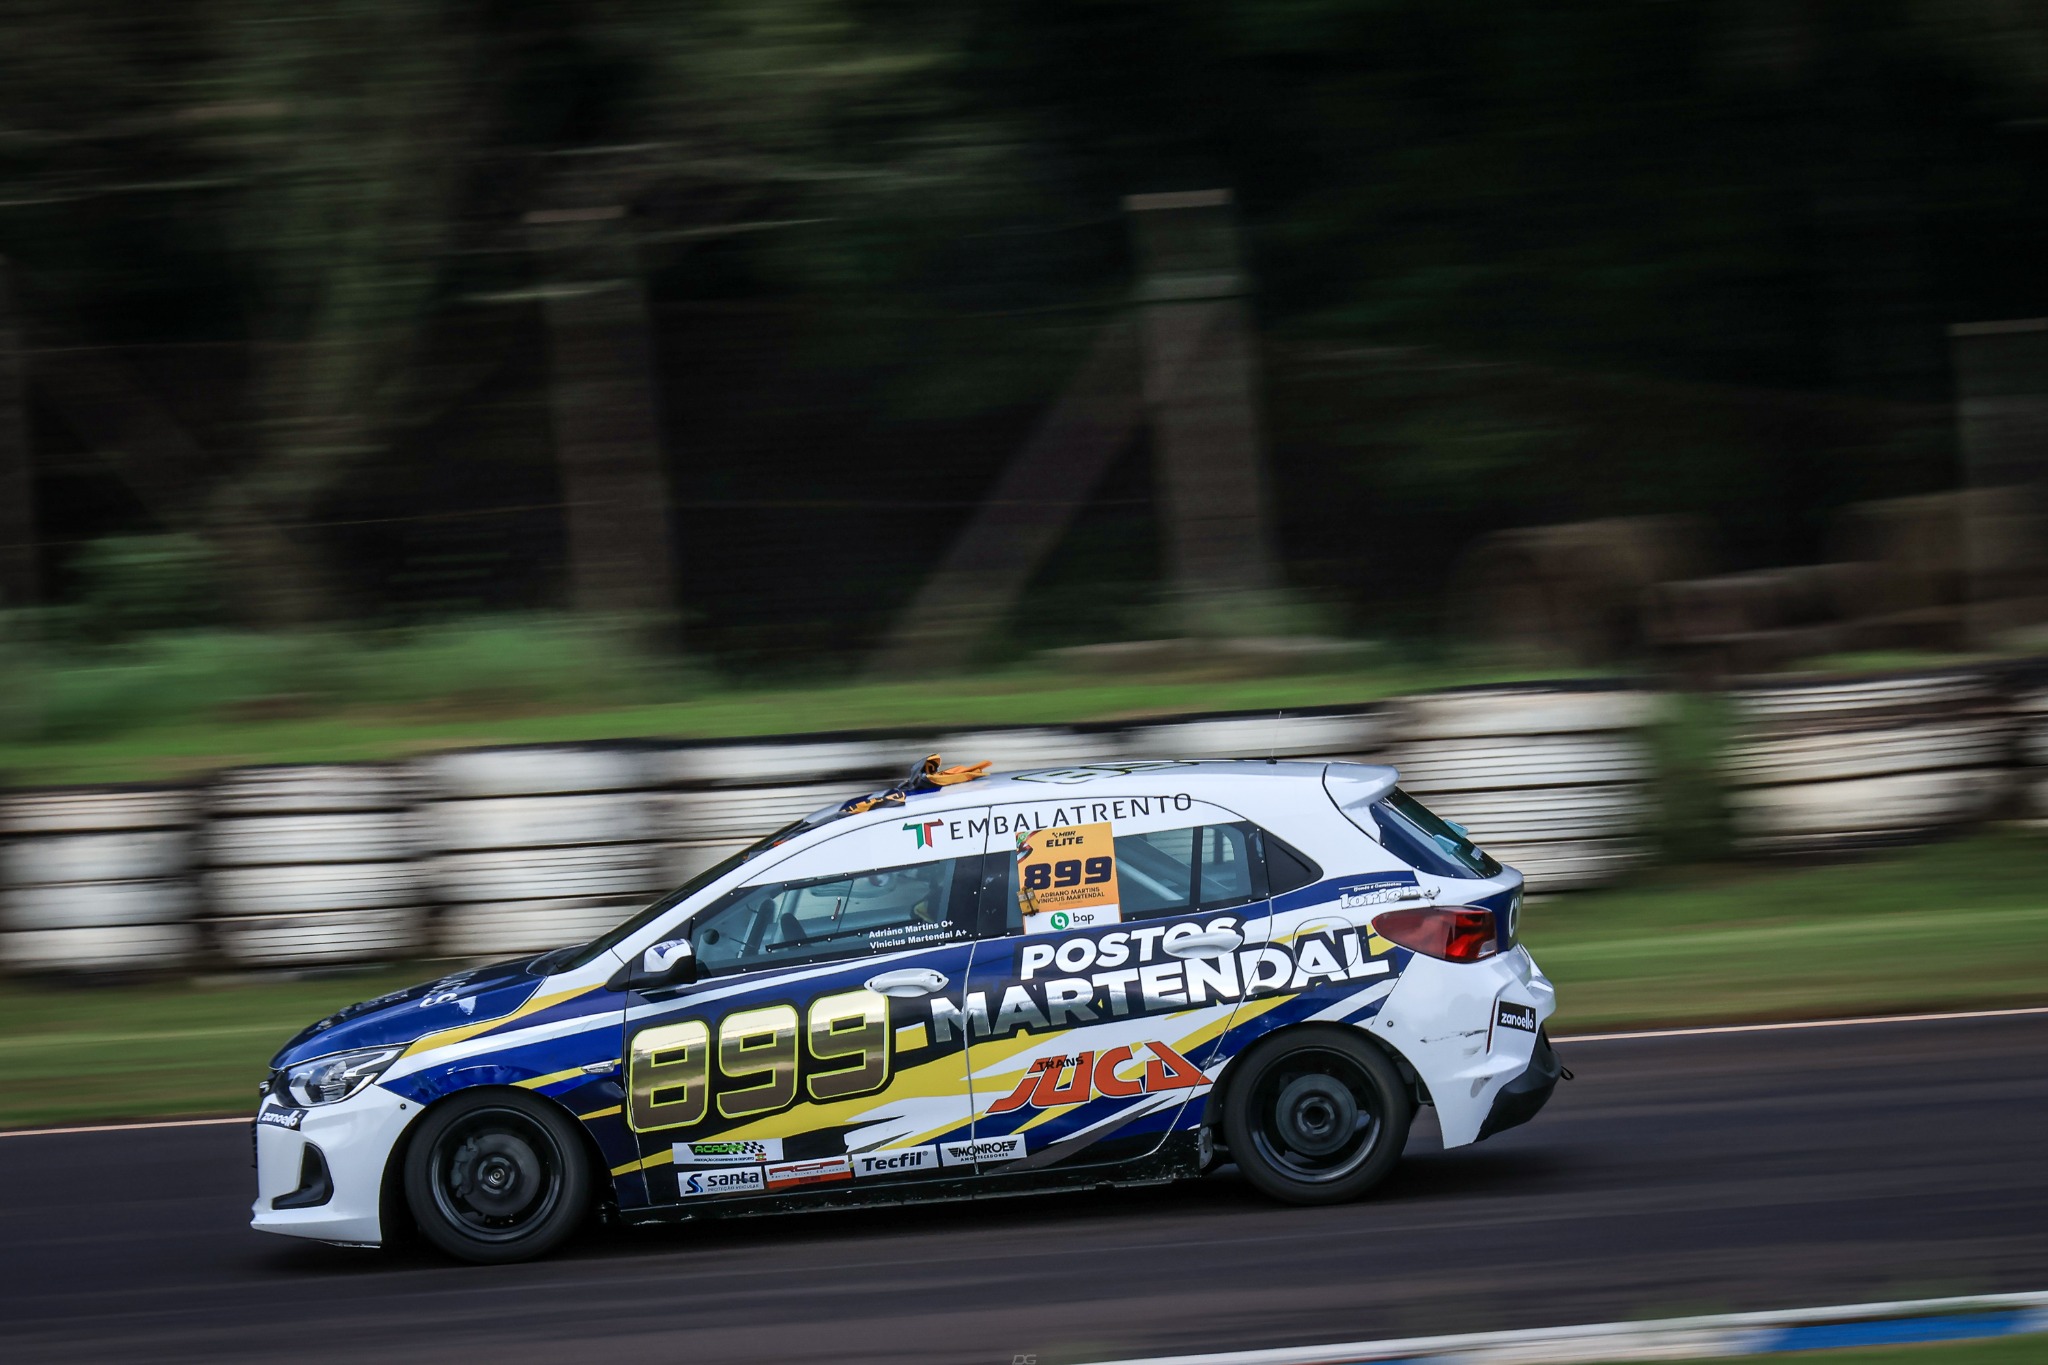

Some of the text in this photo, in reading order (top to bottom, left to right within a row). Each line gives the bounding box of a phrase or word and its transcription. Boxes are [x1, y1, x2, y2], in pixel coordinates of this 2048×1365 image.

[950, 793, 1192, 840] EMBALATRENTO
[1046, 836, 1083, 848] ELITE
[1024, 856, 1113, 890] 899
[1040, 887, 1100, 898] ADRIANO MARTINS
[1066, 892, 1105, 901] MARTENDAL
[1072, 912, 1094, 924] bap
[869, 929, 903, 939] Adriano
[905, 923, 939, 934] Martins
[870, 939, 906, 949] Vinicius
[908, 931, 953, 944] Martendal
[931, 926, 1391, 1043] MARTENDAL
[1501, 1008, 1535, 1030] zanoello
[626, 988, 890, 1134] 899
[1037, 1056, 1084, 1072] TRANS
[957, 1142, 1010, 1157] MONROE
[707, 1171, 759, 1187] santa
